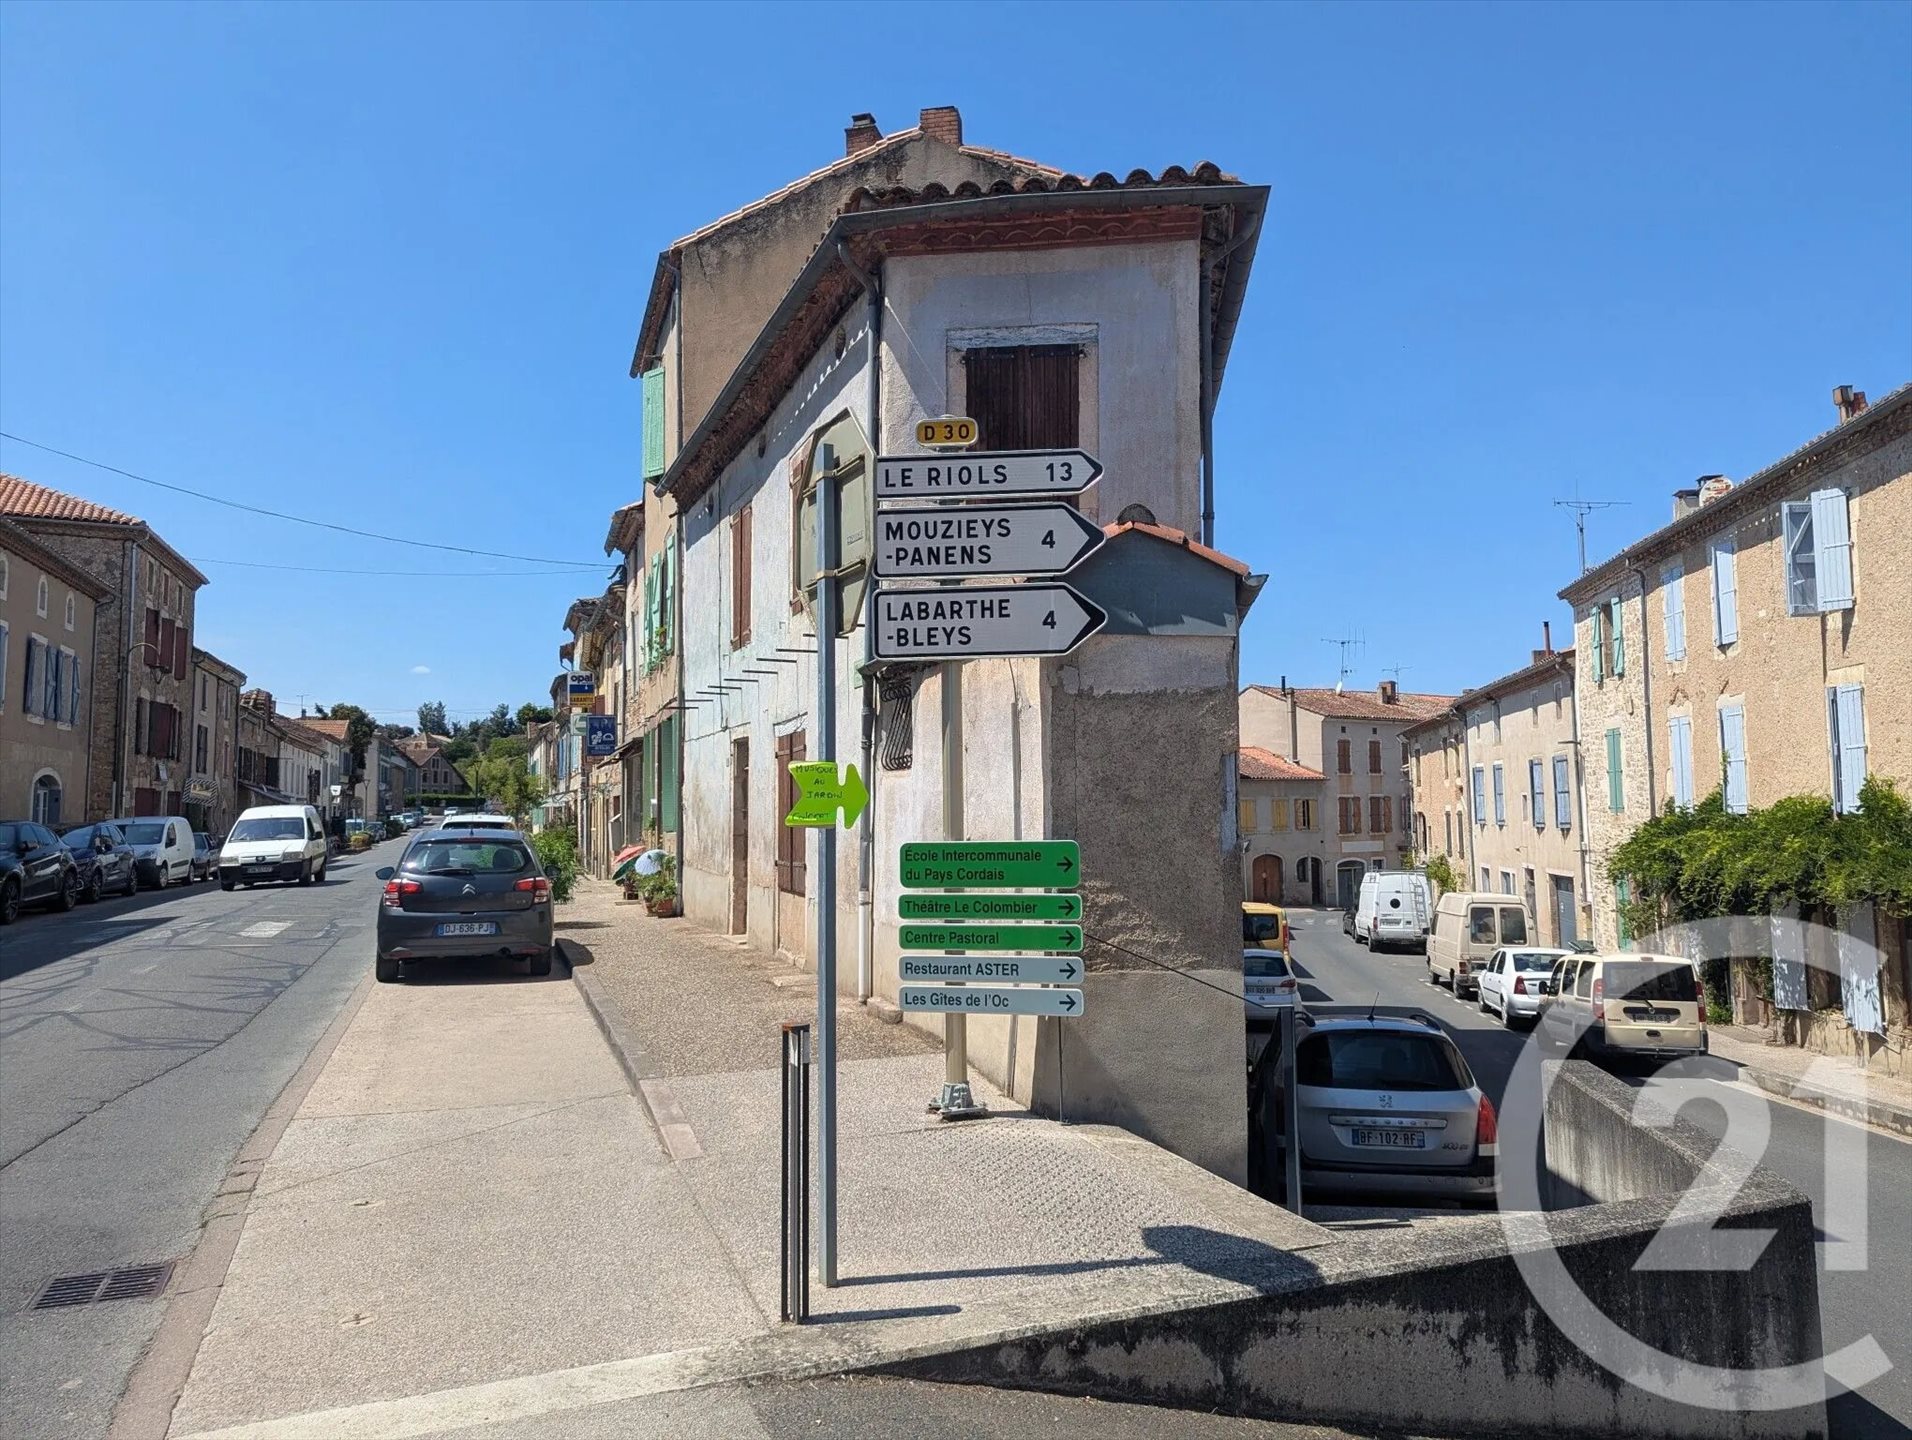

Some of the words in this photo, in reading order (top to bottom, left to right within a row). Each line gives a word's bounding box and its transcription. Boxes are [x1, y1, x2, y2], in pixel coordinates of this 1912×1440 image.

[924, 425, 935, 441] D
[943, 423, 970, 440] 30
[884, 468, 913, 488] LE
[927, 464, 1008, 486] RIOLS
[1045, 462, 1073, 482] 13
[885, 518, 1011, 541] MOUZIEYS
[1041, 529, 1056, 549] 4
[886, 544, 992, 566] -PANENS
[886, 598, 1011, 621] LABARTHE
[1042, 610, 1057, 629] 4
[887, 626, 972, 647] -BLEYS
[570, 673, 593, 684] opal
[905, 846, 938, 862] École
[942, 849, 1042, 862] Intercommunale
[905, 868, 920, 881] du
[924, 868, 953, 883] Pays
[957, 867, 1005, 881] Cordais
[905, 900, 951, 913] Théâtre
[954, 900, 969, 913] Le
[972, 901, 1038, 914] Colombier
[905, 930, 946, 944] Centre
[950, 931, 999, 945] Pastoral
[905, 962, 972, 976] Restaurant
[975, 963, 1019, 976] ASTER
[905, 992, 927, 1006] Les
[930, 992, 962, 1007] Gîtes
[965, 994, 980, 1007] de
[984, 994, 1009, 1008] l'Oc
